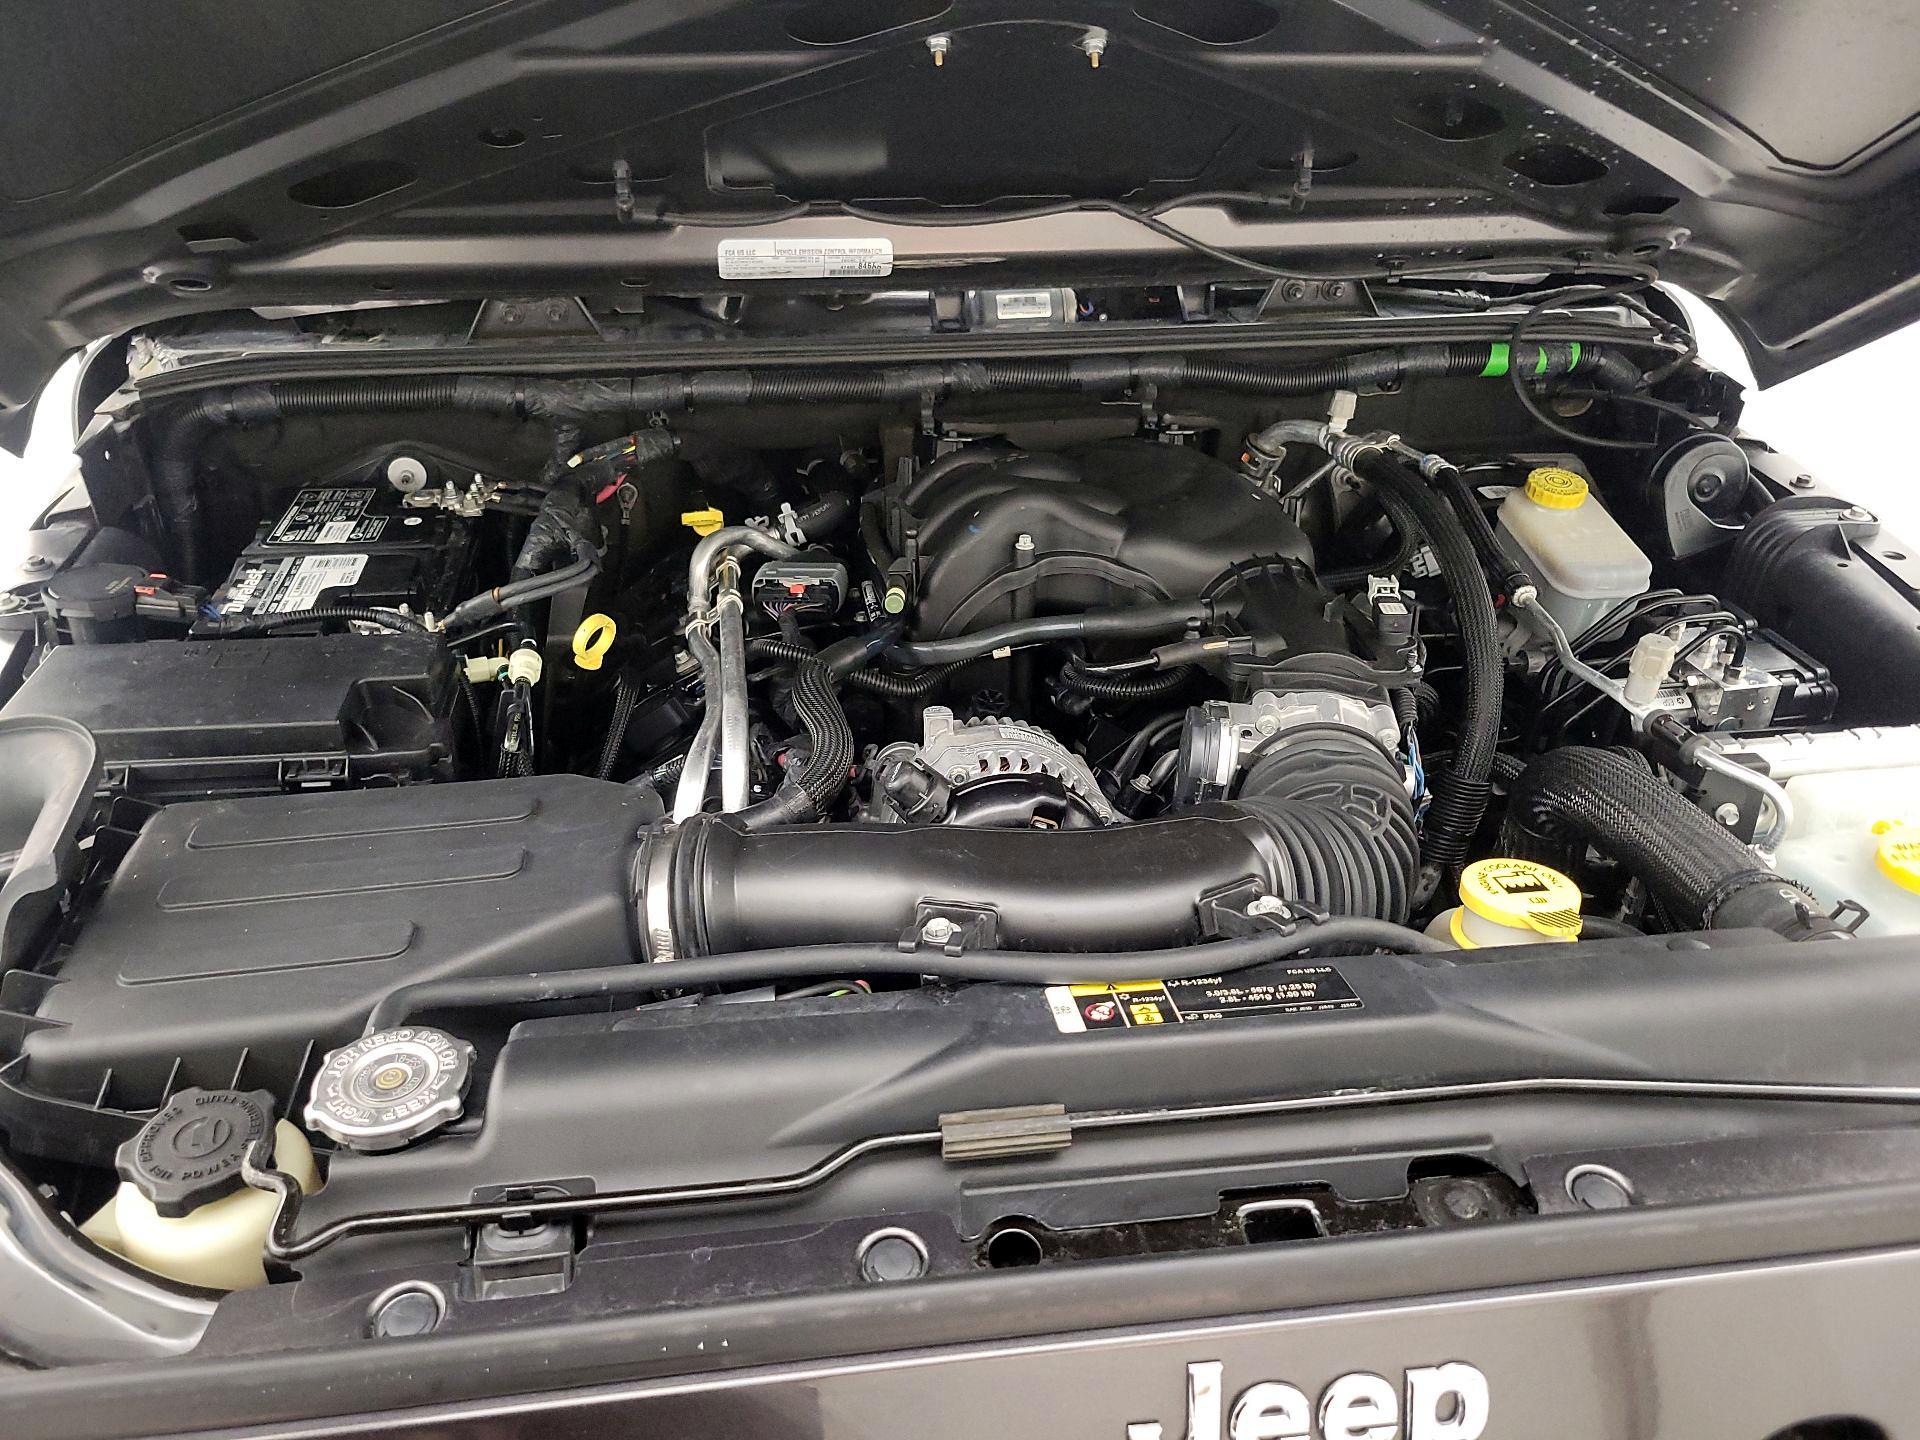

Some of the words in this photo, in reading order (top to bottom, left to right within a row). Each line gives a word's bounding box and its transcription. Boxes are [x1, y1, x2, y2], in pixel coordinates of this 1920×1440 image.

[220, 568, 267, 615] Duralast
[1483, 863, 1538, 873] COOLANT
[358, 1029, 415, 1052] OPEN
[382, 1090, 439, 1122] KEEP
[1126, 1360, 1490, 1440] Jeep
